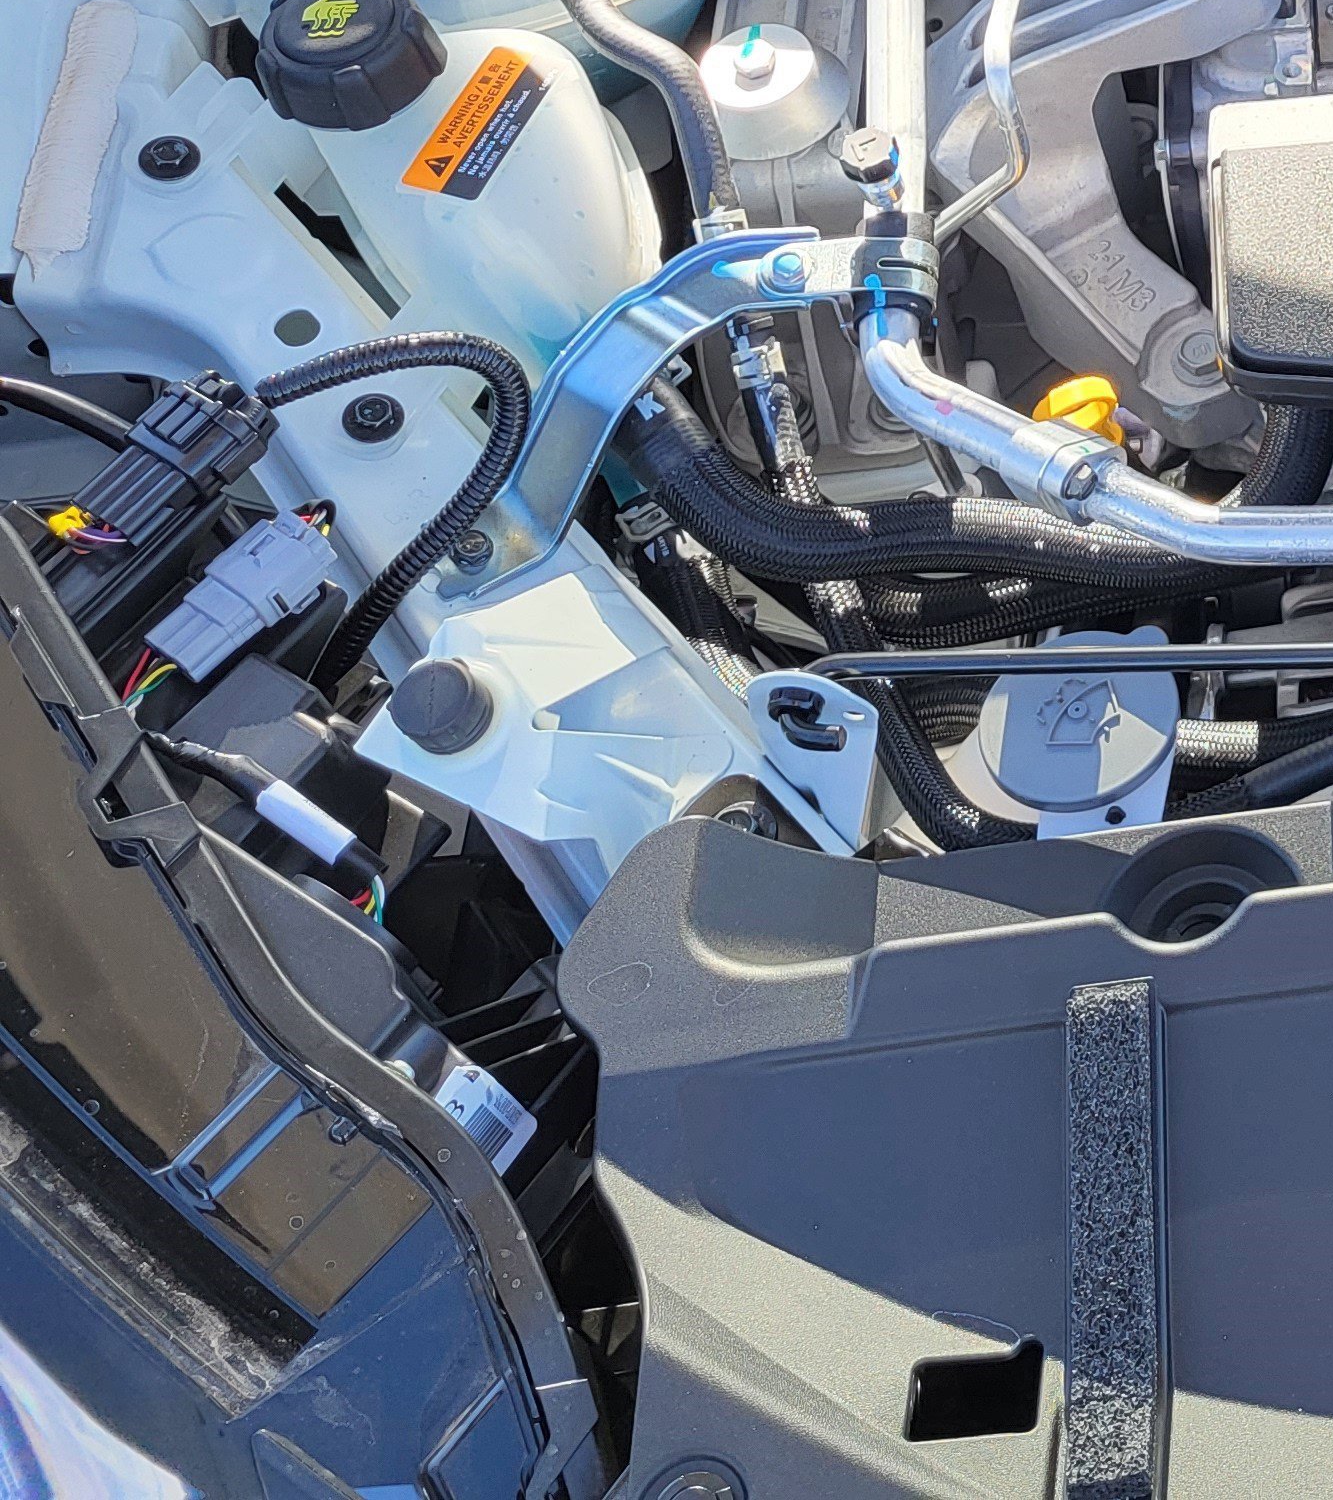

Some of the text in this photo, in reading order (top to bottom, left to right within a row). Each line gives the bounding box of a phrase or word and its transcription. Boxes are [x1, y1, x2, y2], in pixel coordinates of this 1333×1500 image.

[437, 94, 480, 145] WARNING
[452, 59, 519, 150] AVERTISSEMENT
[457, 151, 477, 173] Never
[474, 132, 490, 151] open
[487, 110, 503, 133] when
